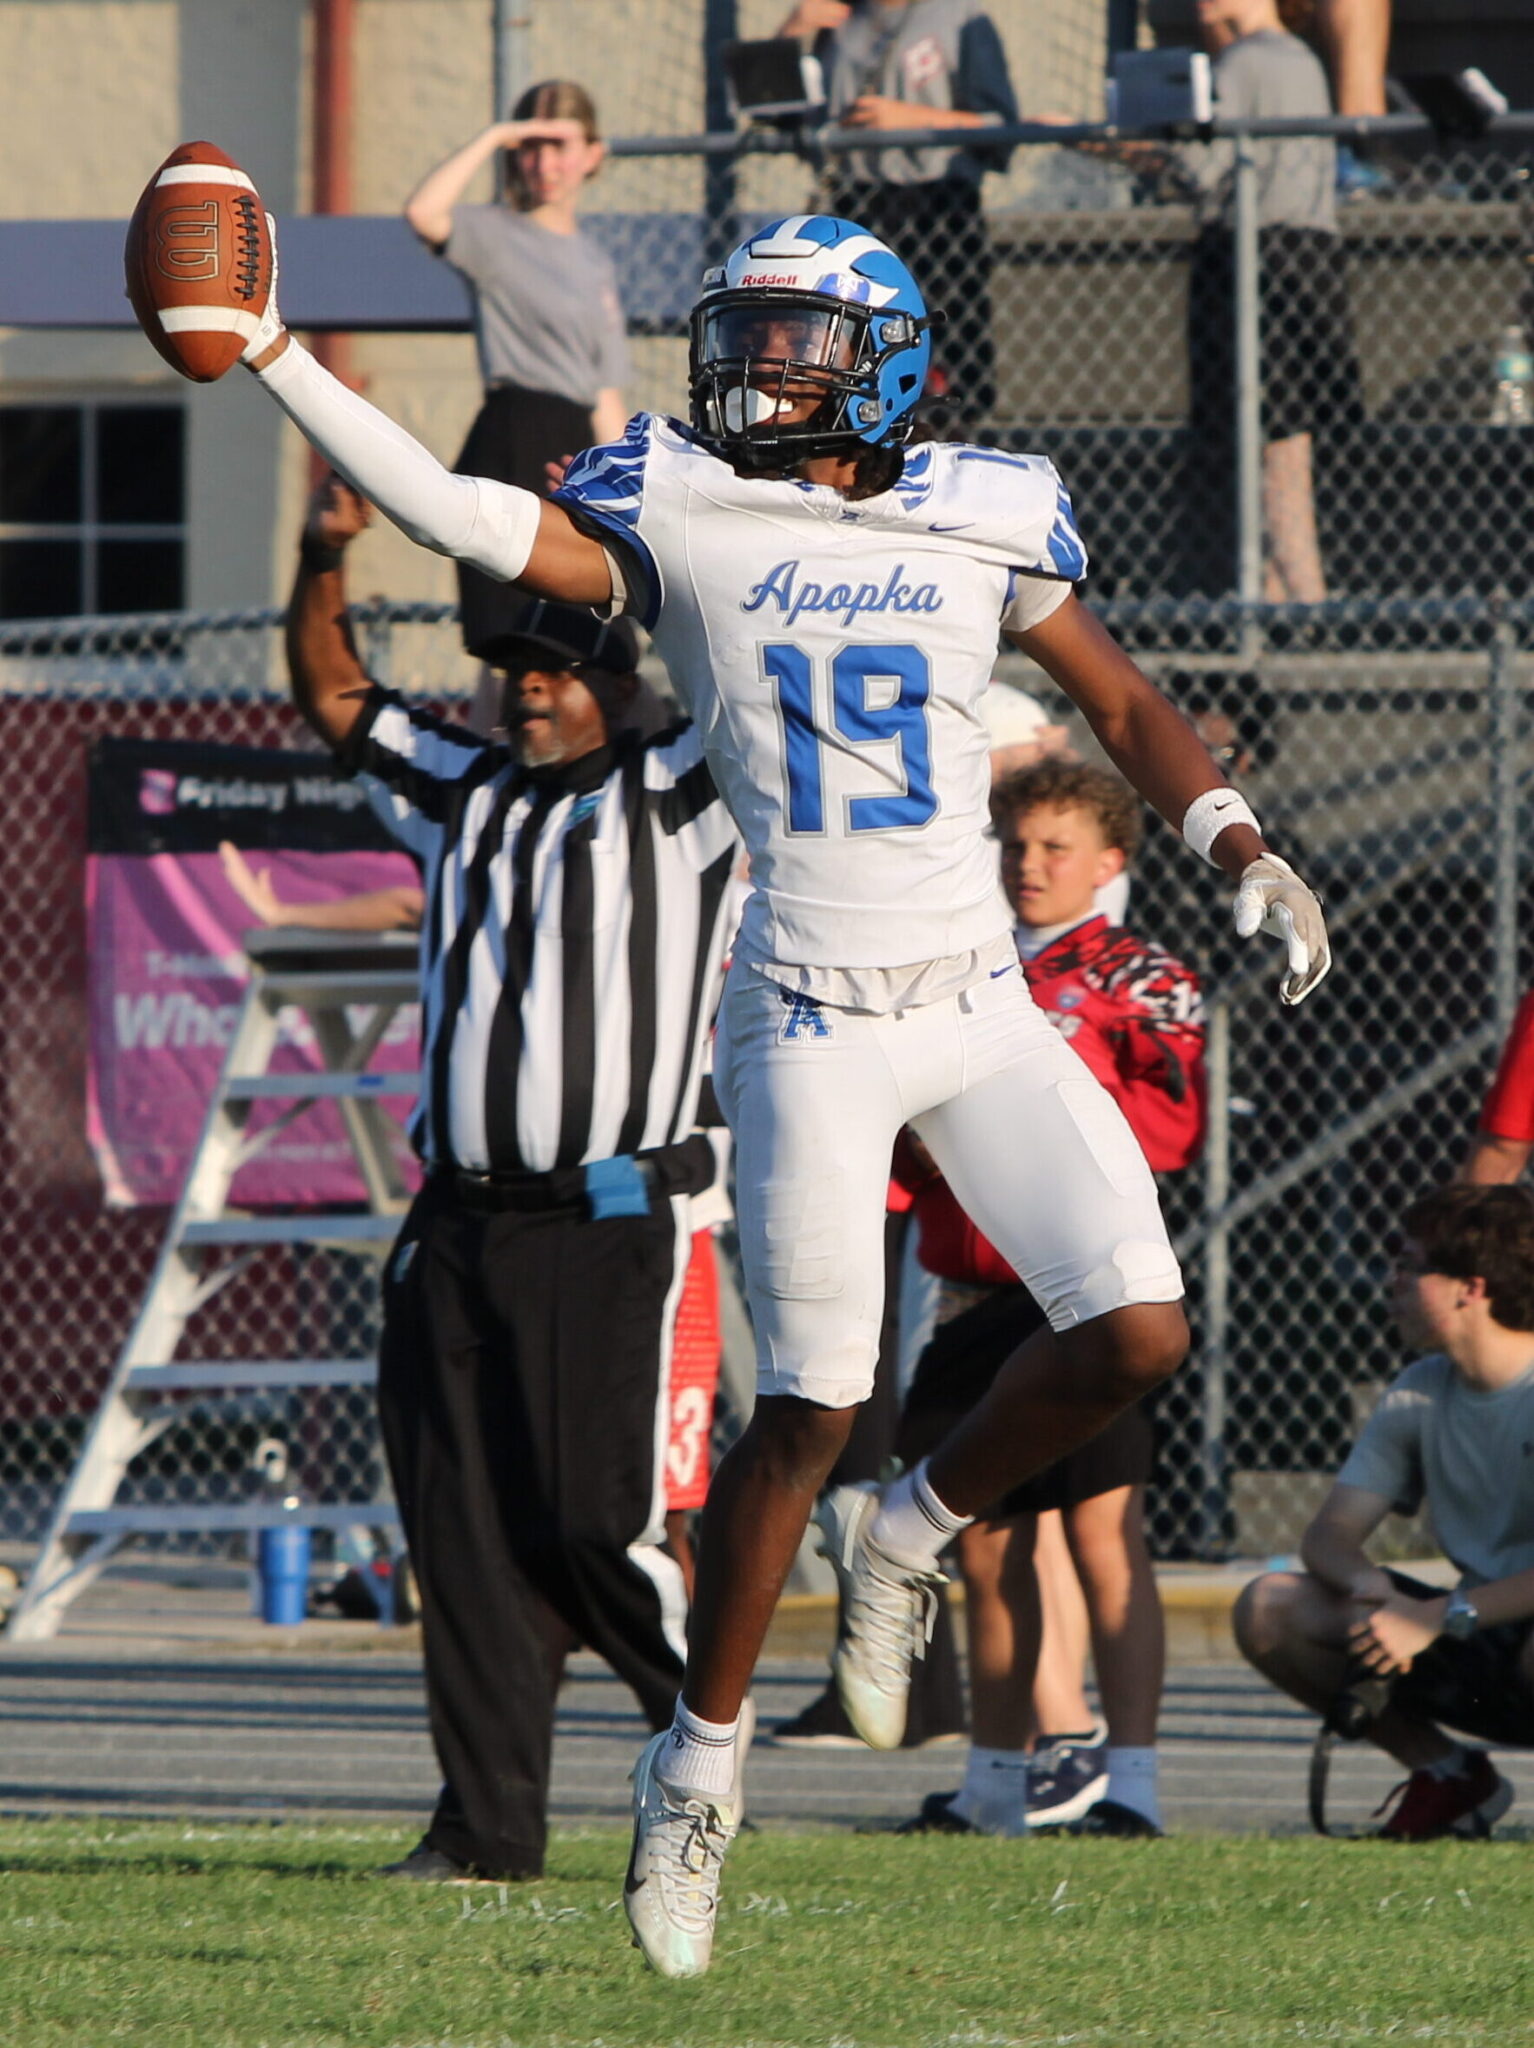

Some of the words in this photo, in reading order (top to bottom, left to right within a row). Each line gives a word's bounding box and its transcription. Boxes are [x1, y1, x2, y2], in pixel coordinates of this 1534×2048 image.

[741, 274, 799, 286] Riddell
[741, 560, 943, 628] Apopka
[756, 640, 941, 838] 19
[177, 775, 287, 812] Friday
[294, 776, 364, 811] Nig
